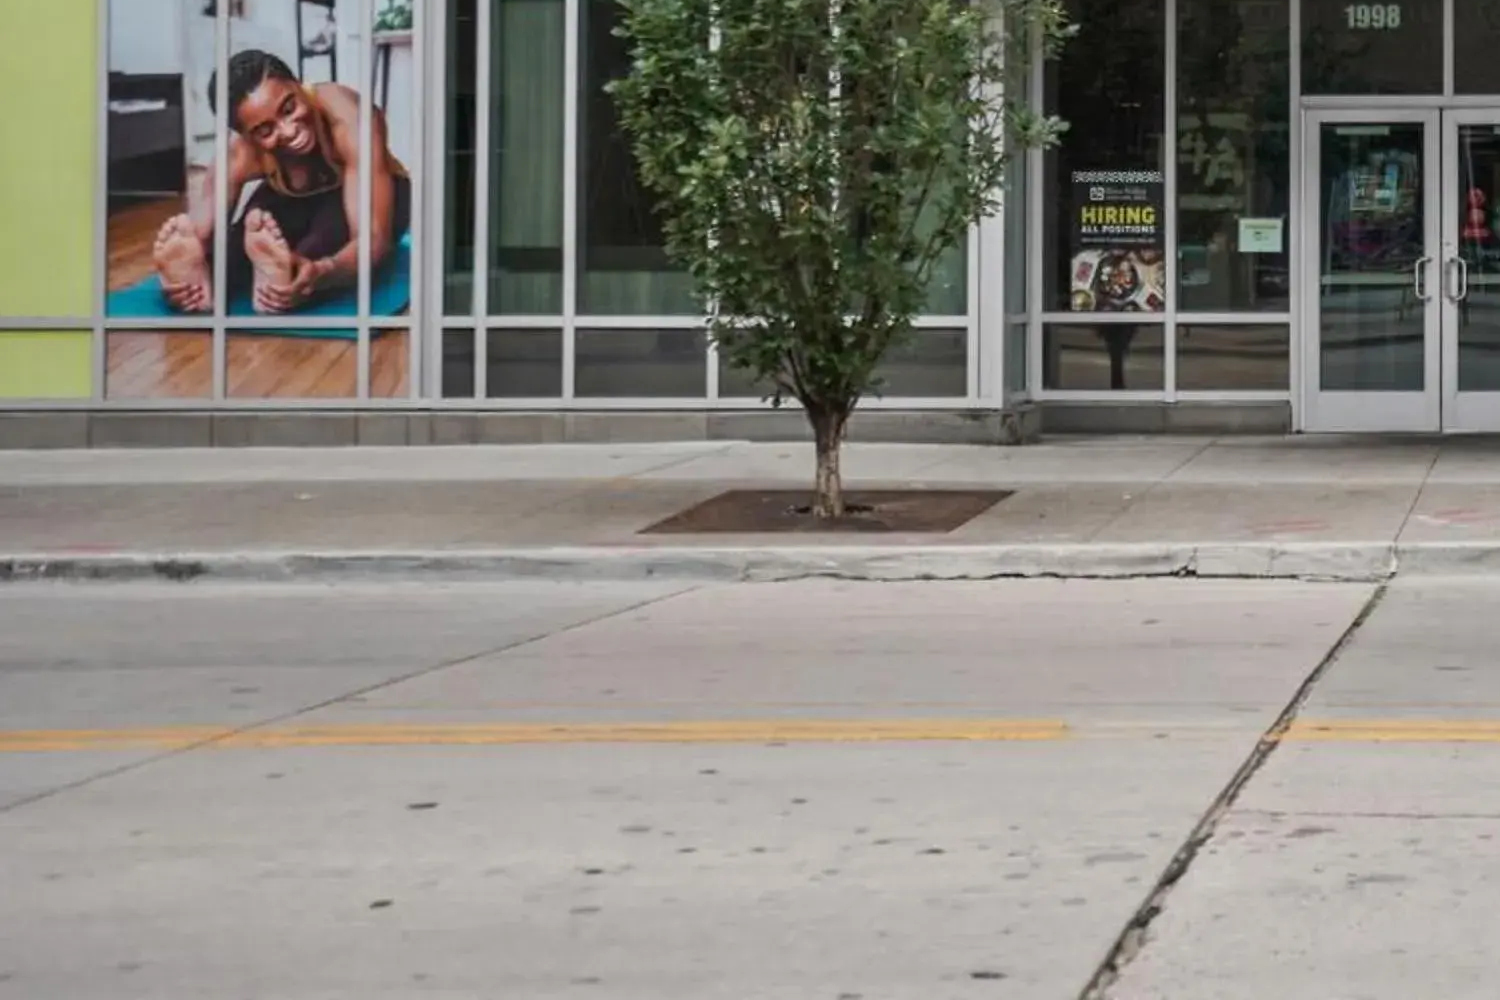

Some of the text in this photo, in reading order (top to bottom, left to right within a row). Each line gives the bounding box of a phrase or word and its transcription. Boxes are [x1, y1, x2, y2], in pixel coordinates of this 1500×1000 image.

[1343, 4, 1401, 29] 1998
[1080, 205, 1156, 225] HIRING
[1080, 225, 1156, 234] ALL POSITIONS
